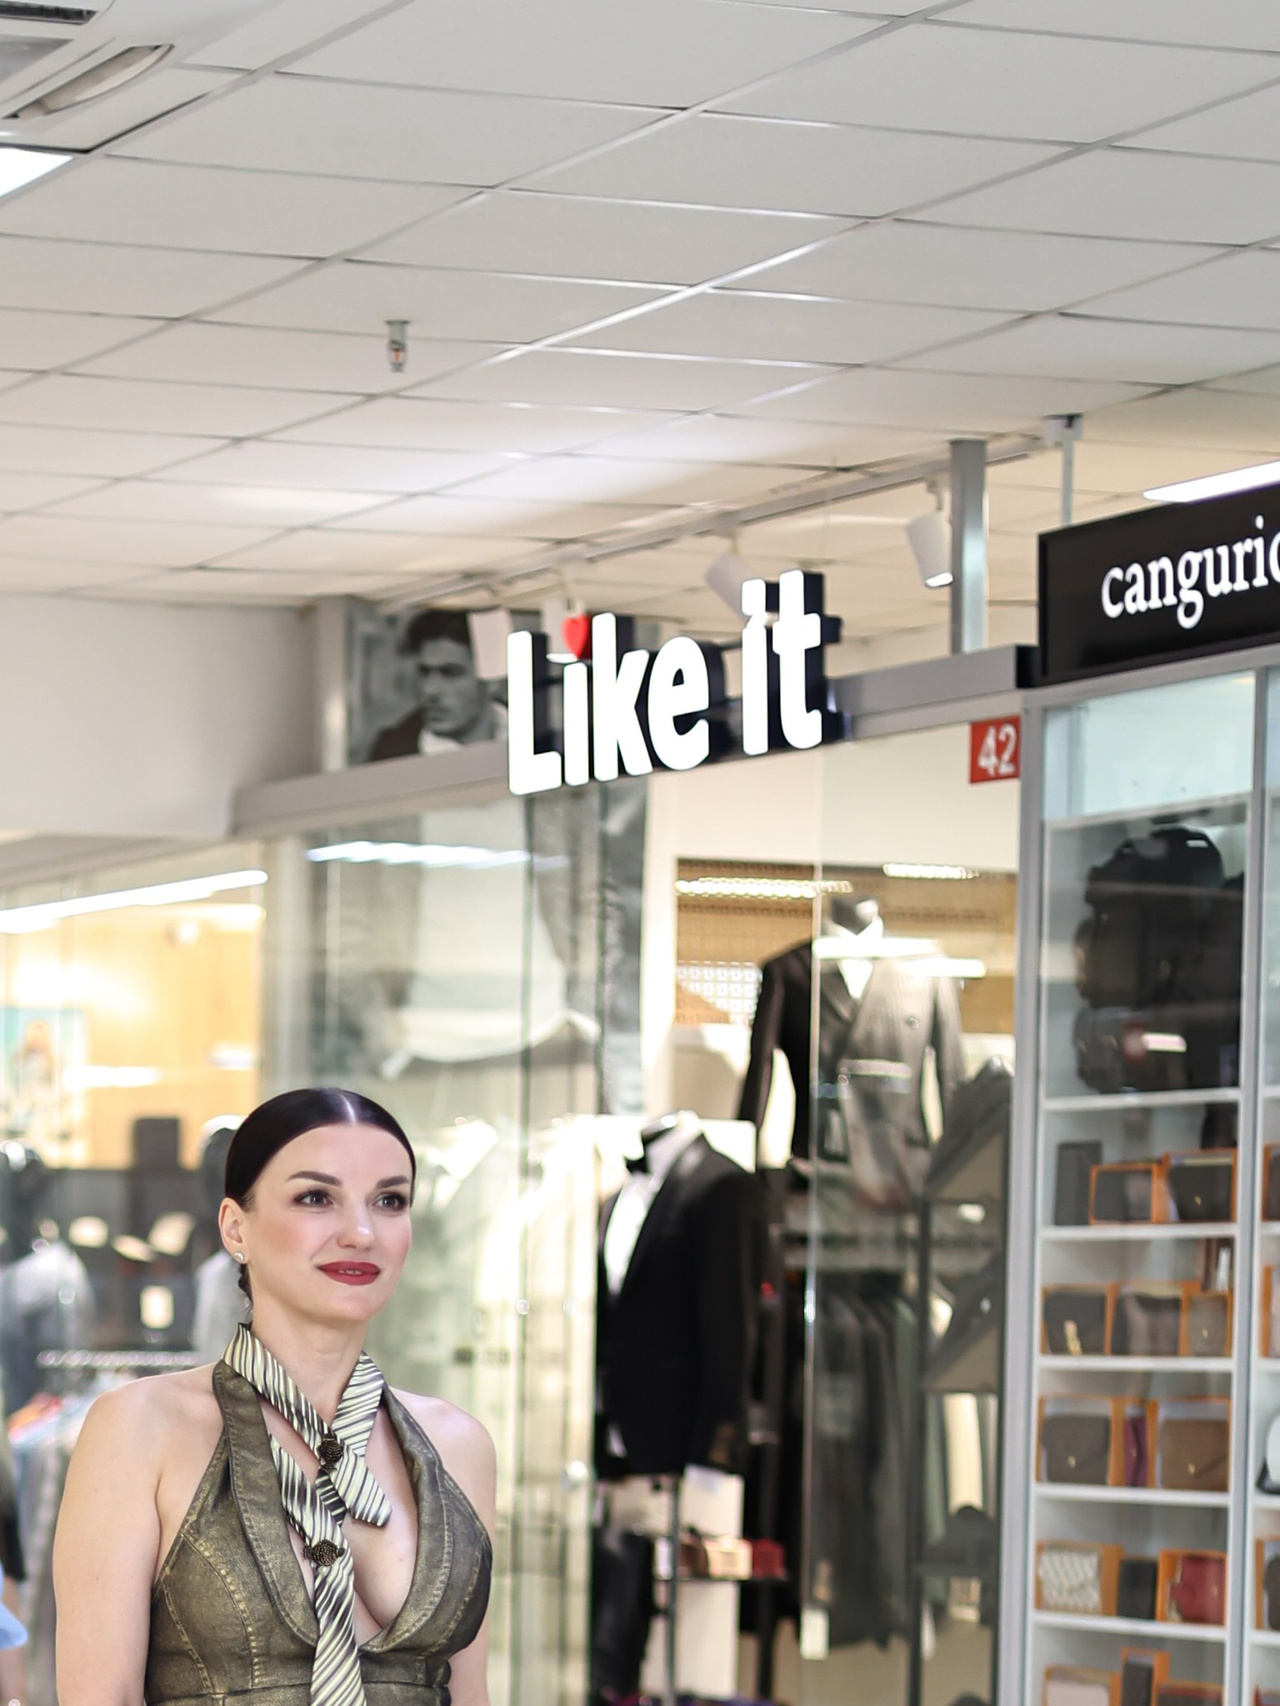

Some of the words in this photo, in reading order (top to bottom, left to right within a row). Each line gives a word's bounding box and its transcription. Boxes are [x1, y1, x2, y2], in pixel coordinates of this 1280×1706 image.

[507, 612, 709, 795] Like
[742, 569, 822, 756] it
[978, 723, 1016, 777] 42
